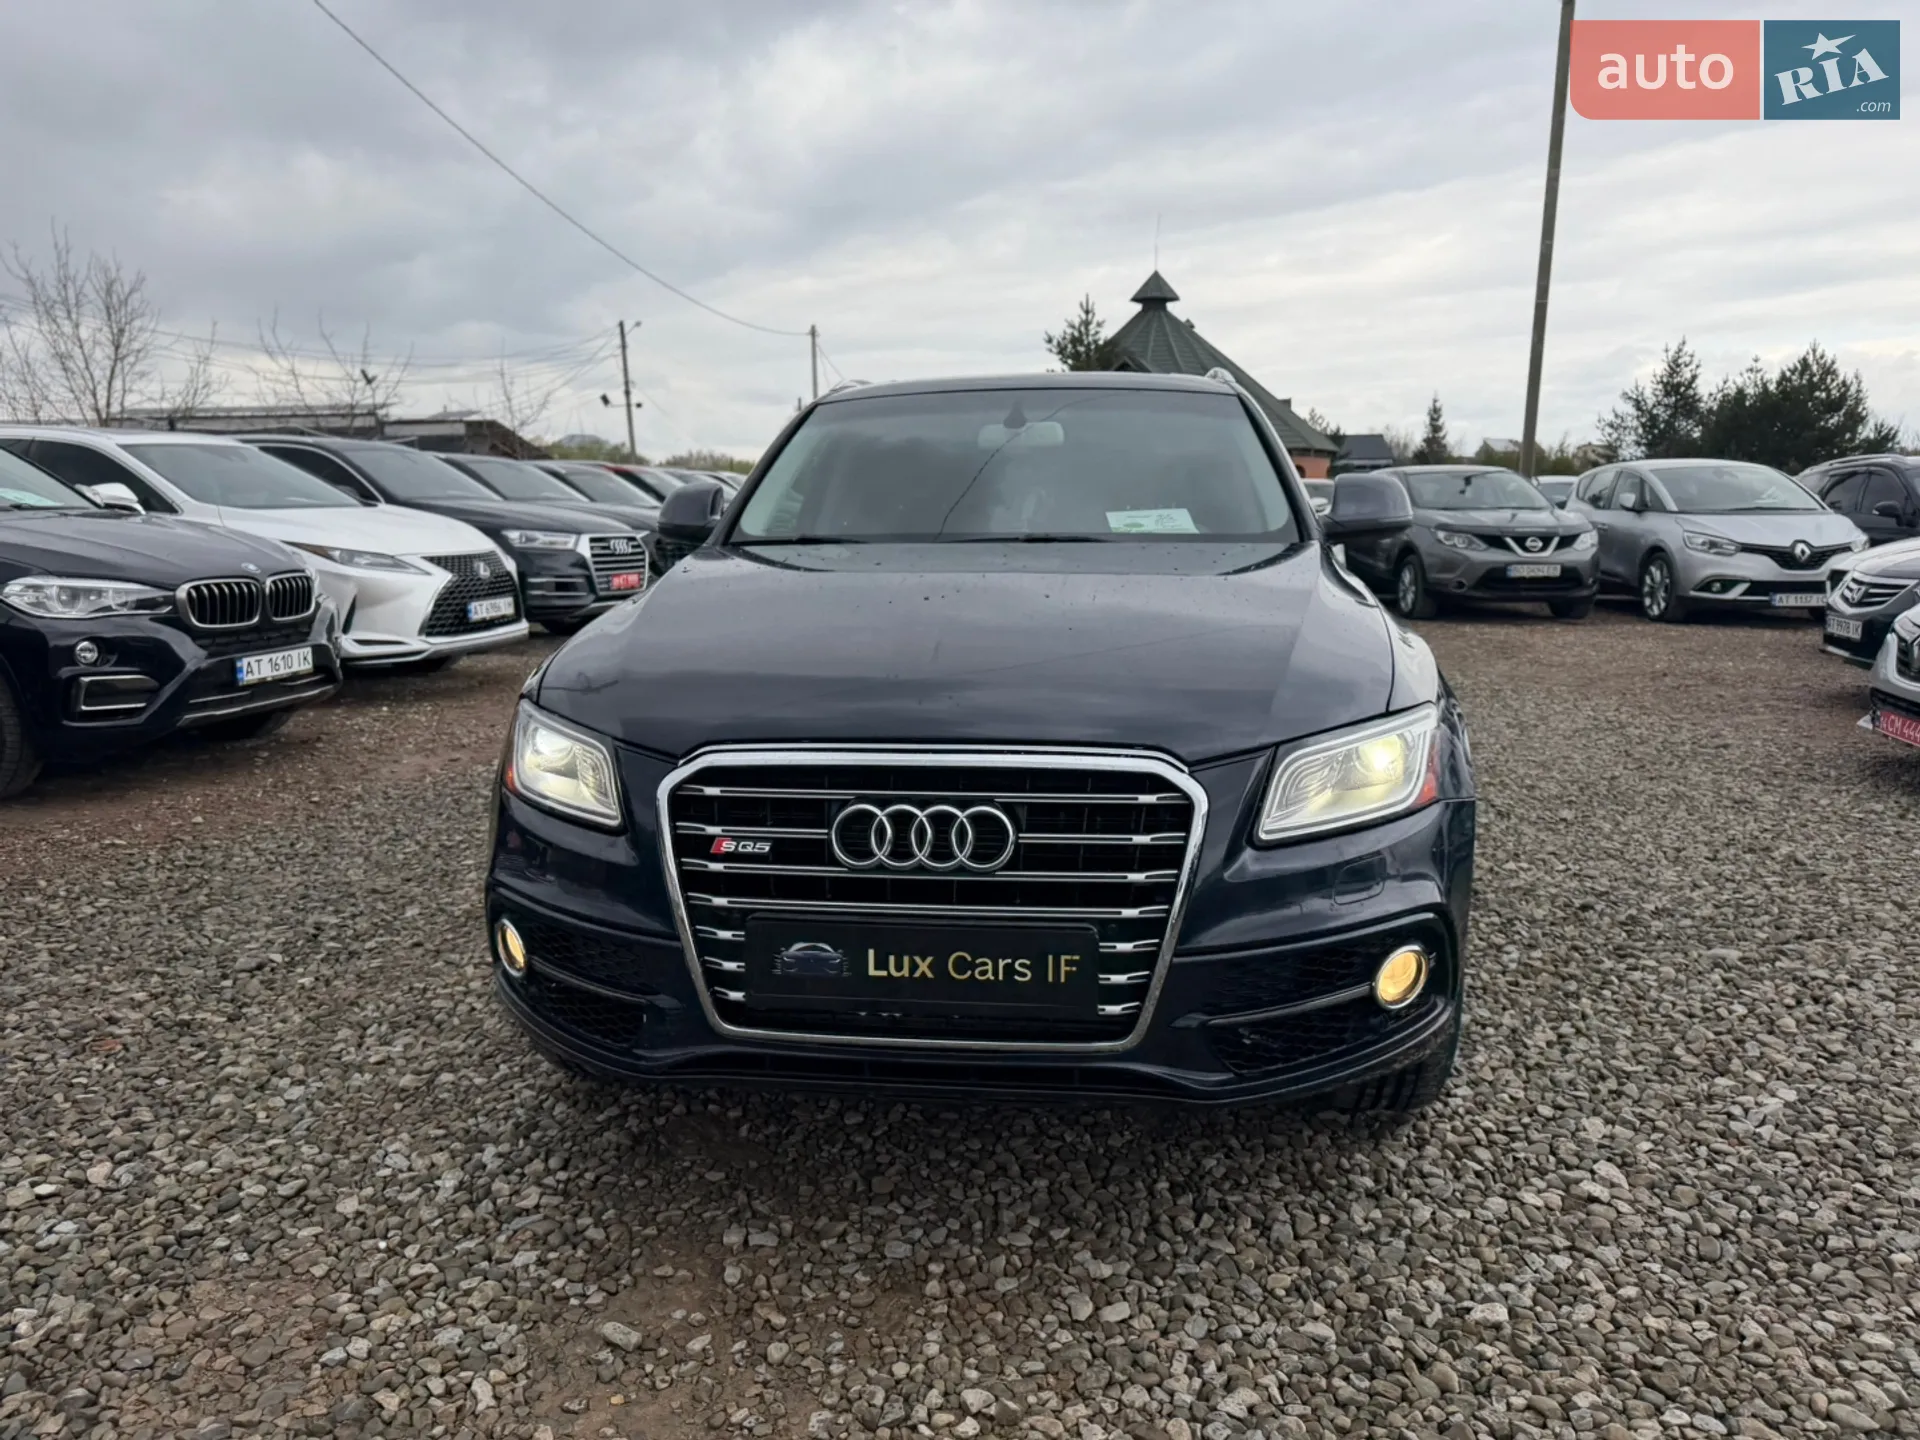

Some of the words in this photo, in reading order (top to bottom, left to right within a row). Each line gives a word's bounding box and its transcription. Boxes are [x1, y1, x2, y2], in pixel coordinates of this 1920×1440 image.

[245, 658, 263, 677] AT
[267, 653, 293, 673] 1610
[297, 649, 311, 668] IK
[719, 841, 772, 853] SQ5
[867, 949, 935, 978] Lux
[948, 952, 1032, 982] Cars
[1047, 954, 1080, 983] IF
